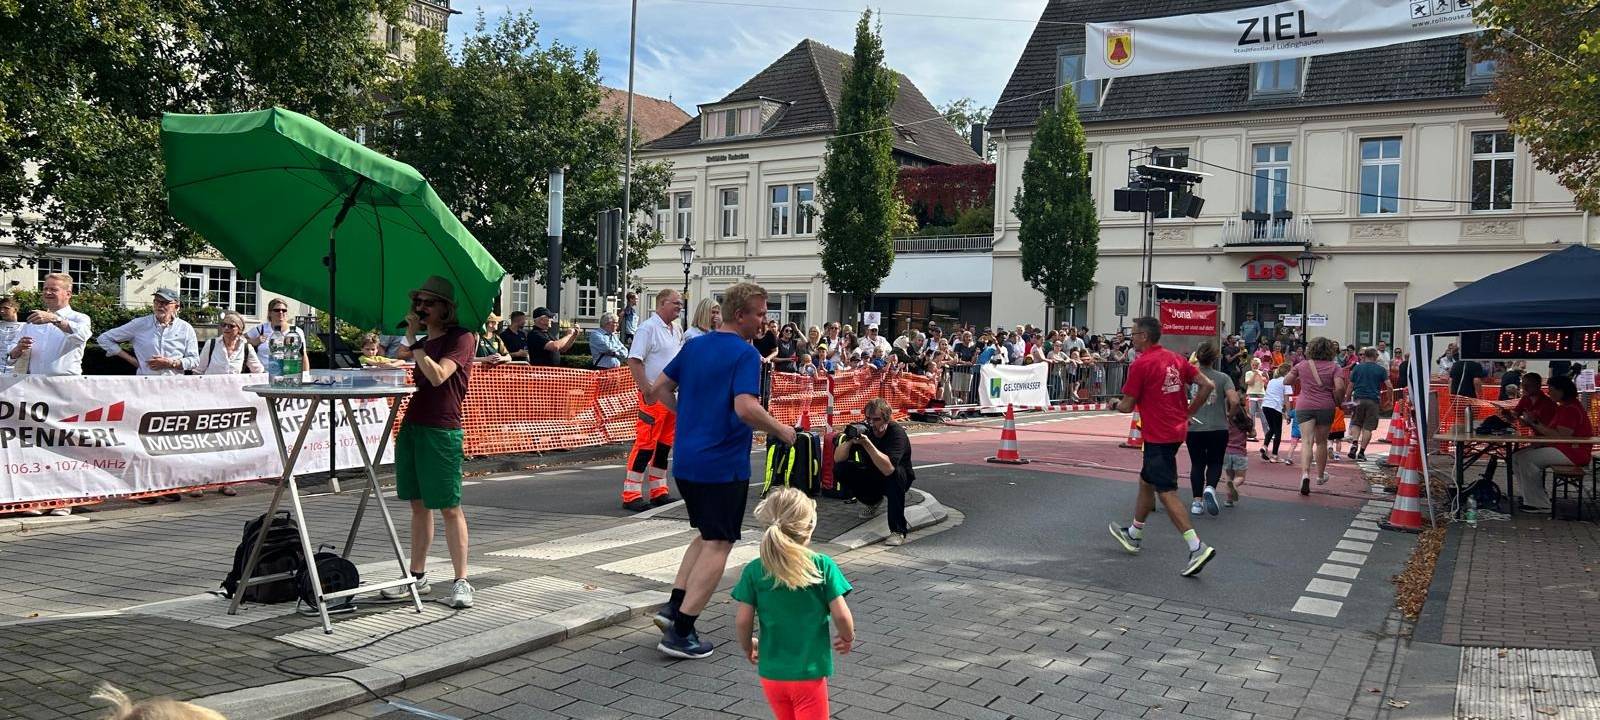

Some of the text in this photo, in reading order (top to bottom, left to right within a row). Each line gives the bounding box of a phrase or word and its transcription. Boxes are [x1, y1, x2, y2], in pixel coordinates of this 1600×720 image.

[1237, 10, 1317, 46] ZIEL
[701, 263, 745, 276] BÜCHEREI
[1003, 382, 1040, 391] GELSENWASSER
[148, 411, 251, 433] DER BESTE
[145, 429, 260, 451] MUSIK-MIX!
[5, 458, 127, 475] 106.3 107.4 MHz
